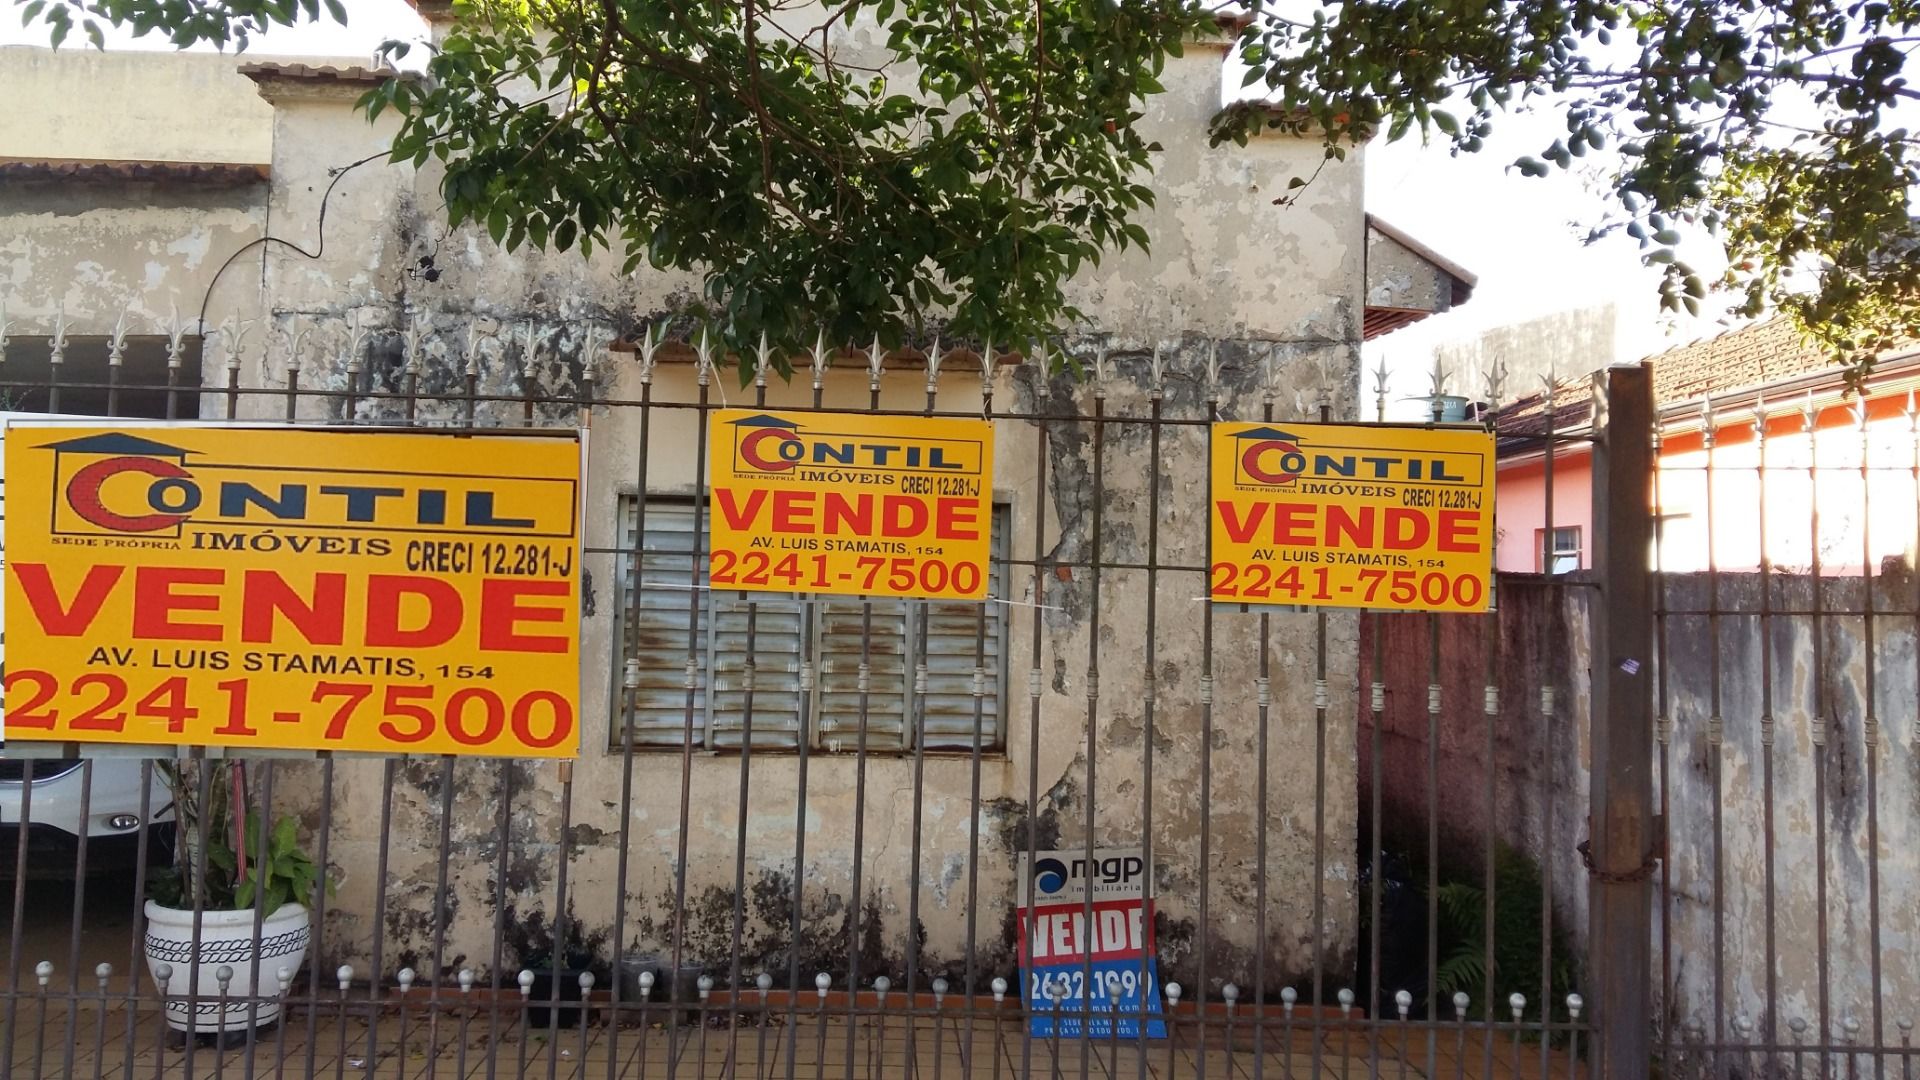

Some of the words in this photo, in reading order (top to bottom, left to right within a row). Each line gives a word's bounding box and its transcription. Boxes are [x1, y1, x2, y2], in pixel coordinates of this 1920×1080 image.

[740, 427, 963, 471] CONTIL
[1242, 440, 1465, 484] CONTIL
[66, 456, 535, 532] CONTIL
[799, 470, 896, 485] IMÓVEIS
[901, 475, 934, 495] CRECI
[936, 477, 981, 497] 12.281-J
[1301, 482, 1397, 498] IMÓVEIS
[714, 488, 980, 541] VENDE
[1402, 488, 1435, 507] CRECI
[1438, 490, 1482, 509] 12.281-J
[51, 536, 98, 547] SEDE
[191, 530, 392, 557] IMÓVEIS
[1215, 501, 1482, 553] VENDE
[406, 541, 473, 574] CRECI
[482, 543, 572, 578] 12.281-J
[750, 536, 775, 548] AV.
[780, 537, 818, 550] LUIS
[824, 538, 911, 556] STAMATIS,
[915, 546, 944, 555] 154
[1251, 549, 1276, 561] AV.
[1282, 550, 1320, 563] LUIS
[1325, 552, 1412, 569] STAMATIS,
[1417, 559, 1445, 568] 154
[710, 549, 981, 594] 2241-7500
[1211, 562, 1483, 607] 2241-7500
[10, 563, 572, 654] VENDE
[87, 647, 138, 668] AV.
[153, 650, 231, 671] LUIS
[244, 652, 425, 682] STAMATIS,
[436, 664, 496, 681] 154
[4, 669, 573, 749] 2241-7500
[1071, 857, 1144, 884] mgp
